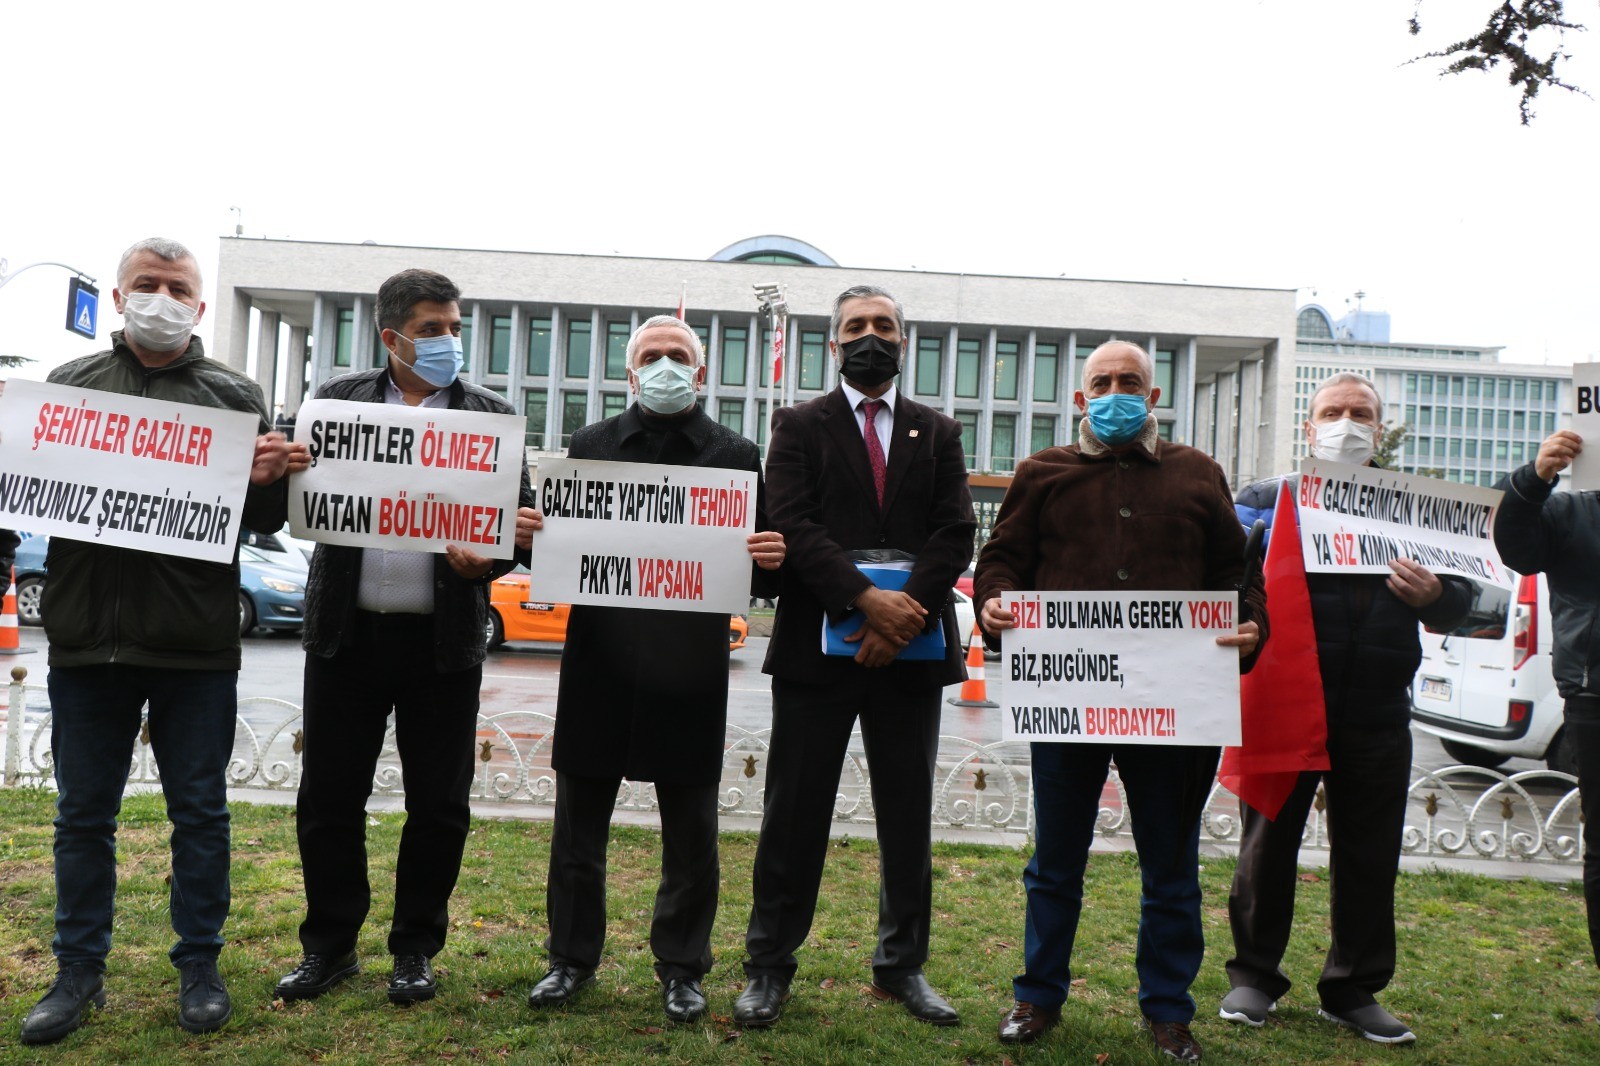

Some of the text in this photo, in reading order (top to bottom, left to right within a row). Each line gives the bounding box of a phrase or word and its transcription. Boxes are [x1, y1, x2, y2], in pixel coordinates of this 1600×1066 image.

[32, 398, 213, 467] ŞEHİTLER GAZİLER
[309, 415, 500, 473] ŞEHİTLER ÖLMEZ!
[95, 487, 231, 545] ŞEREFİMİZDİR
[303, 491, 504, 545] VATAN BÖLÜNMEZ!
[542, 470, 749, 528] GAZİLERE YAPTIĞIN TEHDİDİ
[1300, 467, 1495, 540] BİZ GAZİLERİMİZİN YANINDAYIZ!
[1312, 533, 1333, 566] YA
[1334, 526, 1357, 566] SİZ
[1358, 529, 1399, 566] KİMİN
[637, 557, 703, 600] YAPSANA
[1010, 595, 1233, 629] BİZİ BULMANA GEREK YOK!!
[1011, 647, 1124, 688] BİZ,BUGÜNDE,
[1011, 706, 1176, 736] YARINDA BURDAYIZ!!
